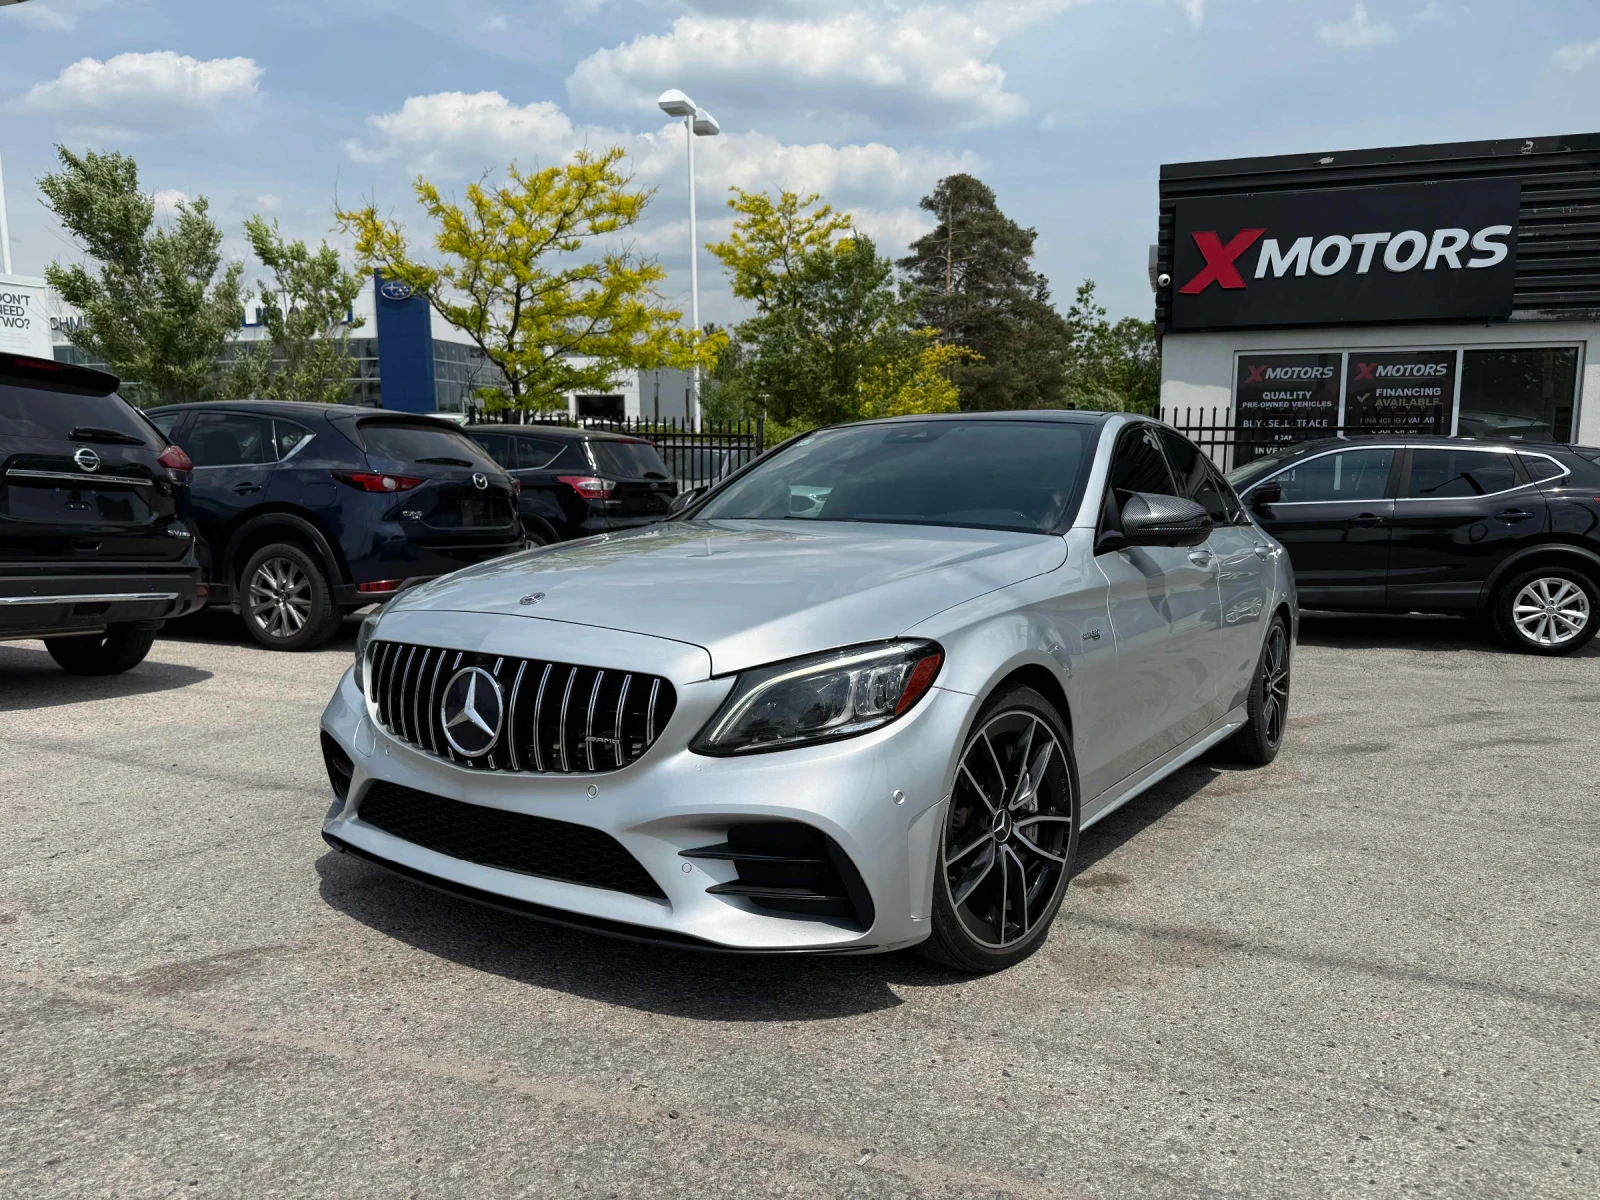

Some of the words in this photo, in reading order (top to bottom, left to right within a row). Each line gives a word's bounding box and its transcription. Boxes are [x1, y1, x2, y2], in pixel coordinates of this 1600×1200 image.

[1254, 225, 1512, 279] MOTORS
[0, 293, 30, 306] ON'T
[0, 316, 30, 329] WO?
[1265, 366, 1334, 379] MOTORS
[1375, 363, 1448, 377] MOTORS
[1262, 391, 1313, 401] QUALITY
[1375, 387, 1441, 397] FINANCING
[1375, 397, 1442, 407] AVAILABLE
[1268, 420, 1290, 428] SEL
